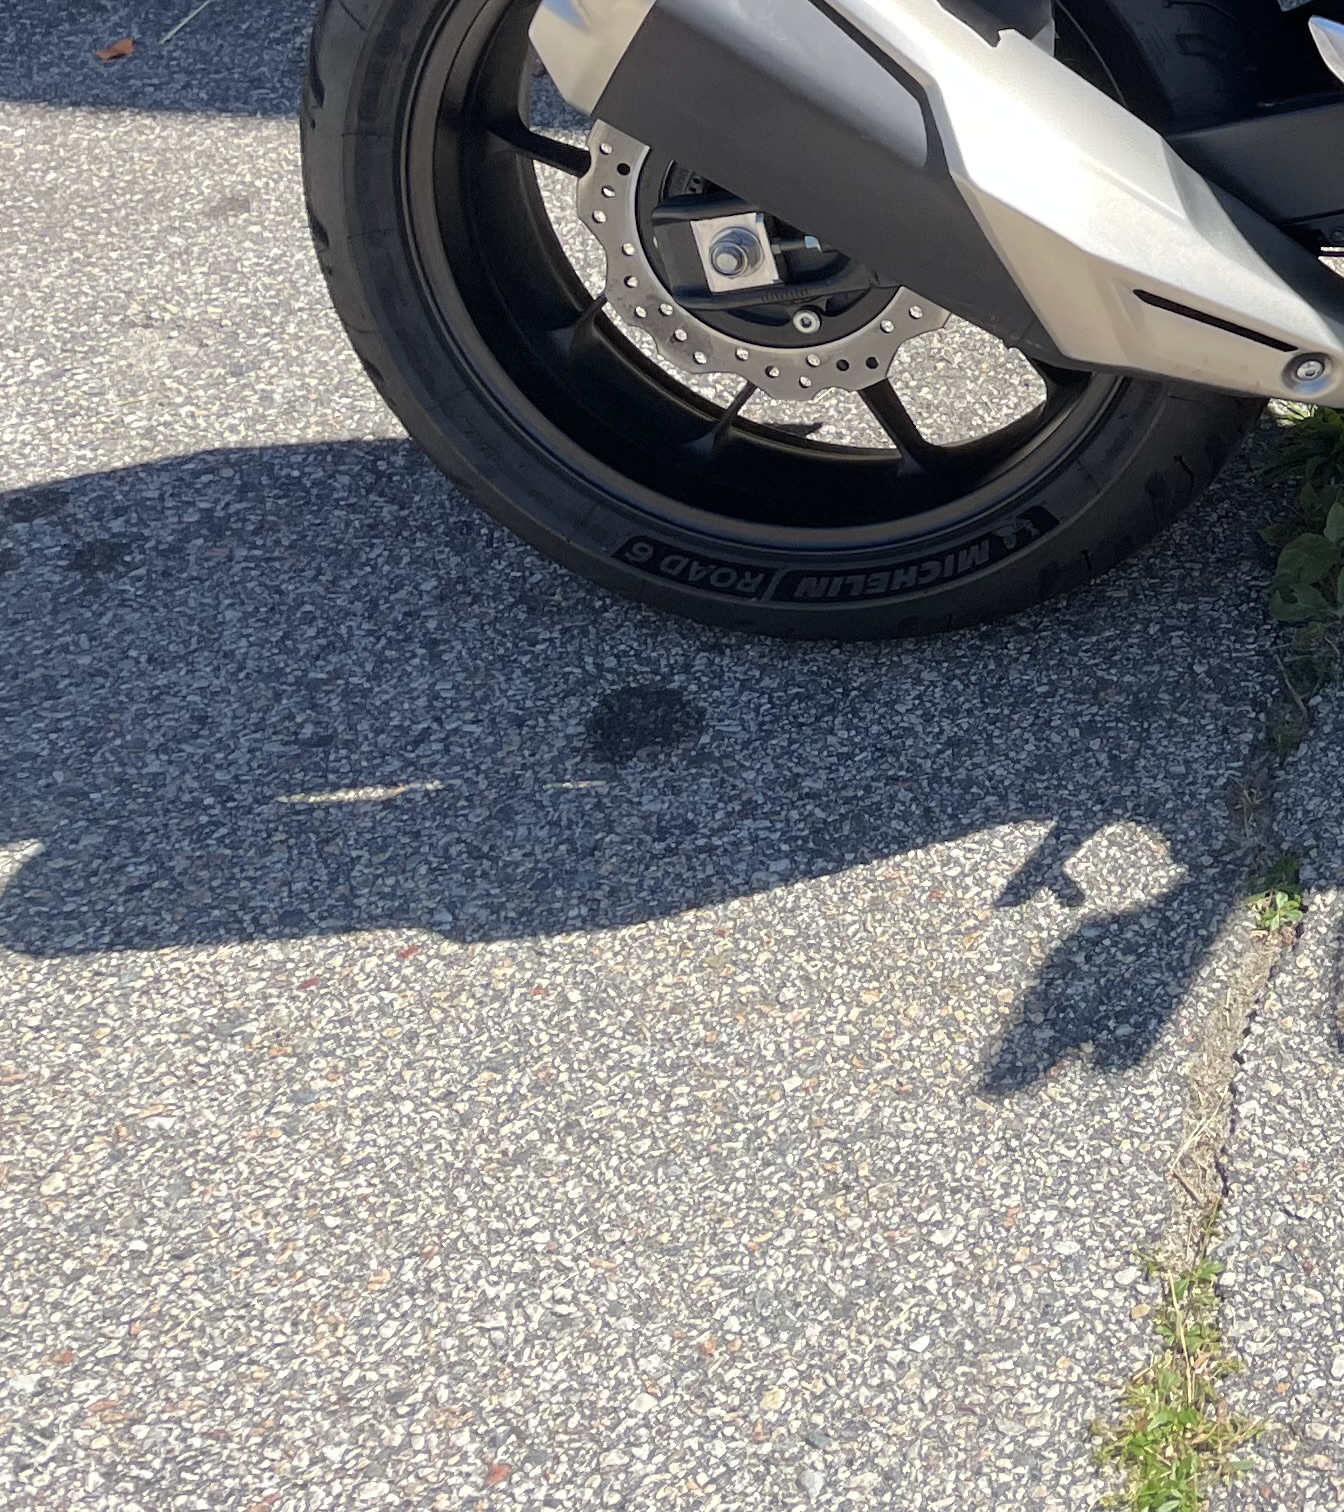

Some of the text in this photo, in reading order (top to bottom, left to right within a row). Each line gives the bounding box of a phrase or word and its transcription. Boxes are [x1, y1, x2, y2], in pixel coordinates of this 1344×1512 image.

[625, 539, 990, 598] MICHELIN ROAD 6
